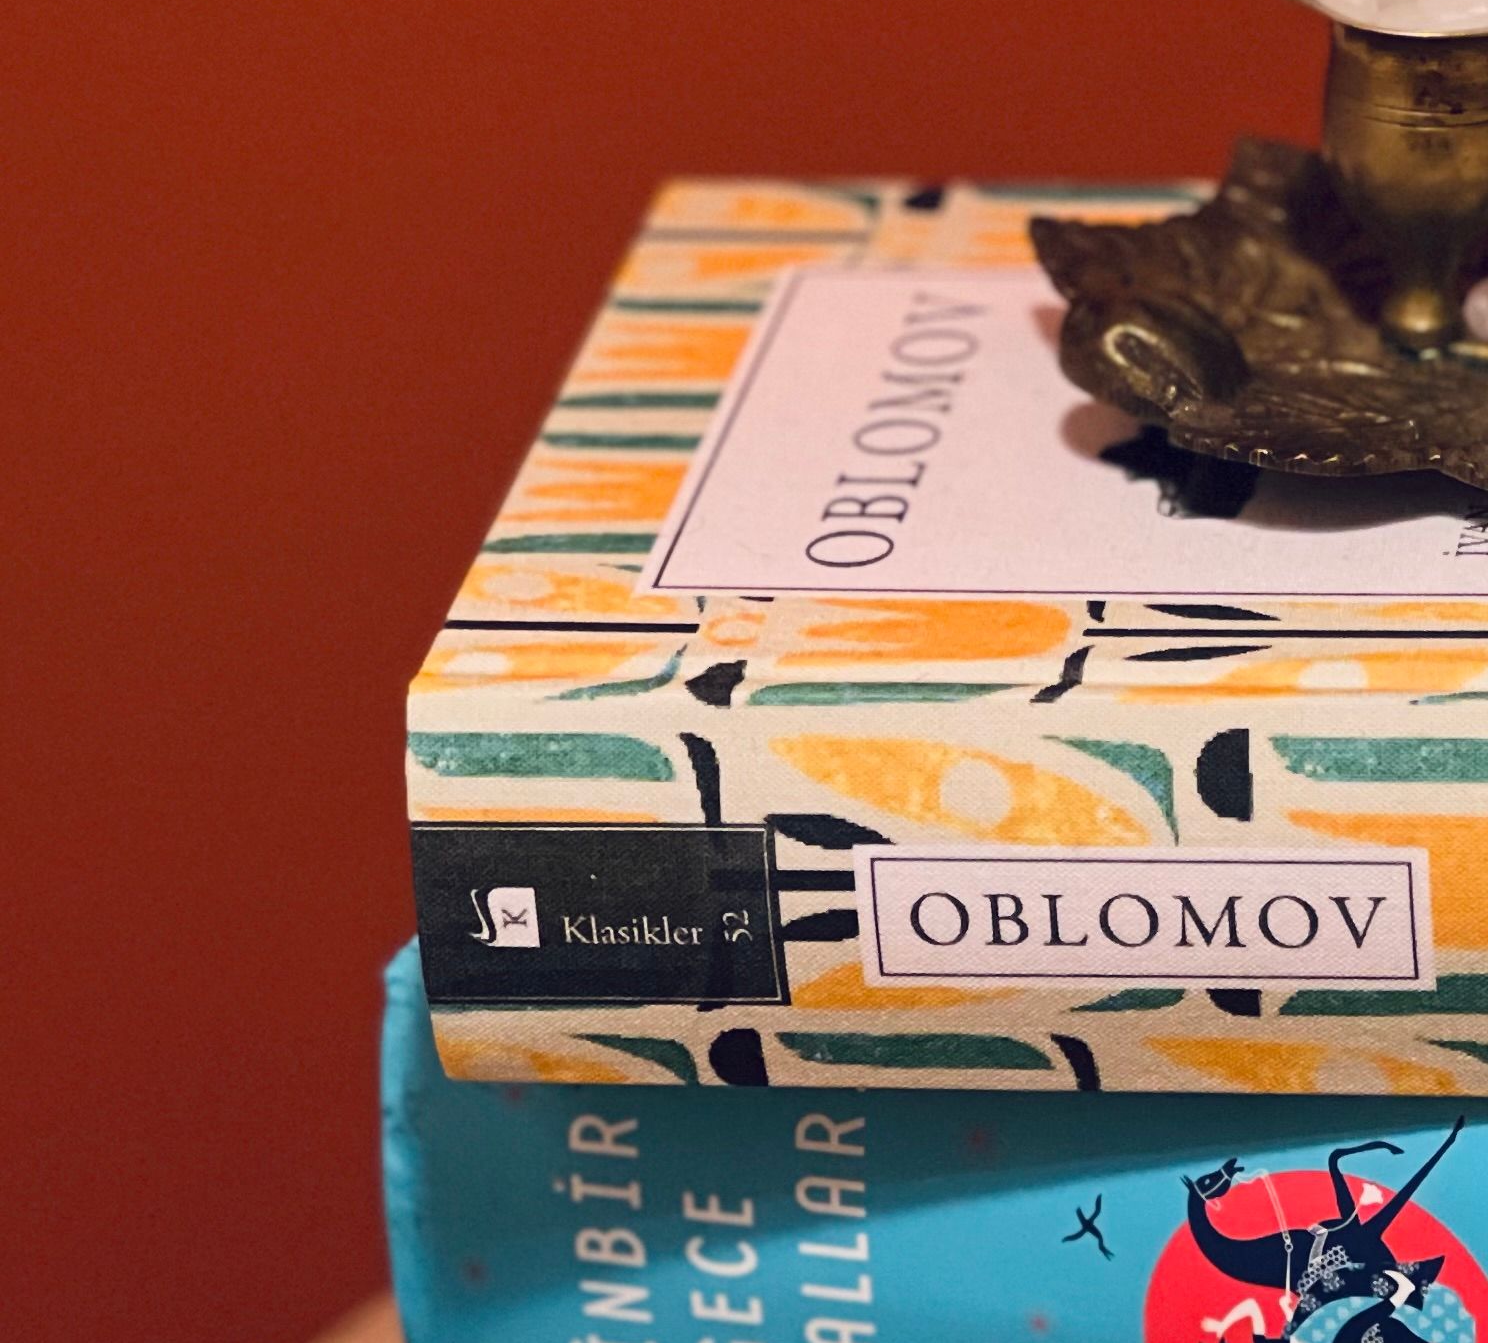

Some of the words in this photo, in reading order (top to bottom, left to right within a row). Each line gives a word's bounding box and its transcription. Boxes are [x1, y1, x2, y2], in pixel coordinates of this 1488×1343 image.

[805, 292, 993, 567] OBLOMOV
[562, 914, 703, 946] Klasikler
[722, 910, 752, 942] 52
[909, 891, 1387, 948] OBLOMOV
